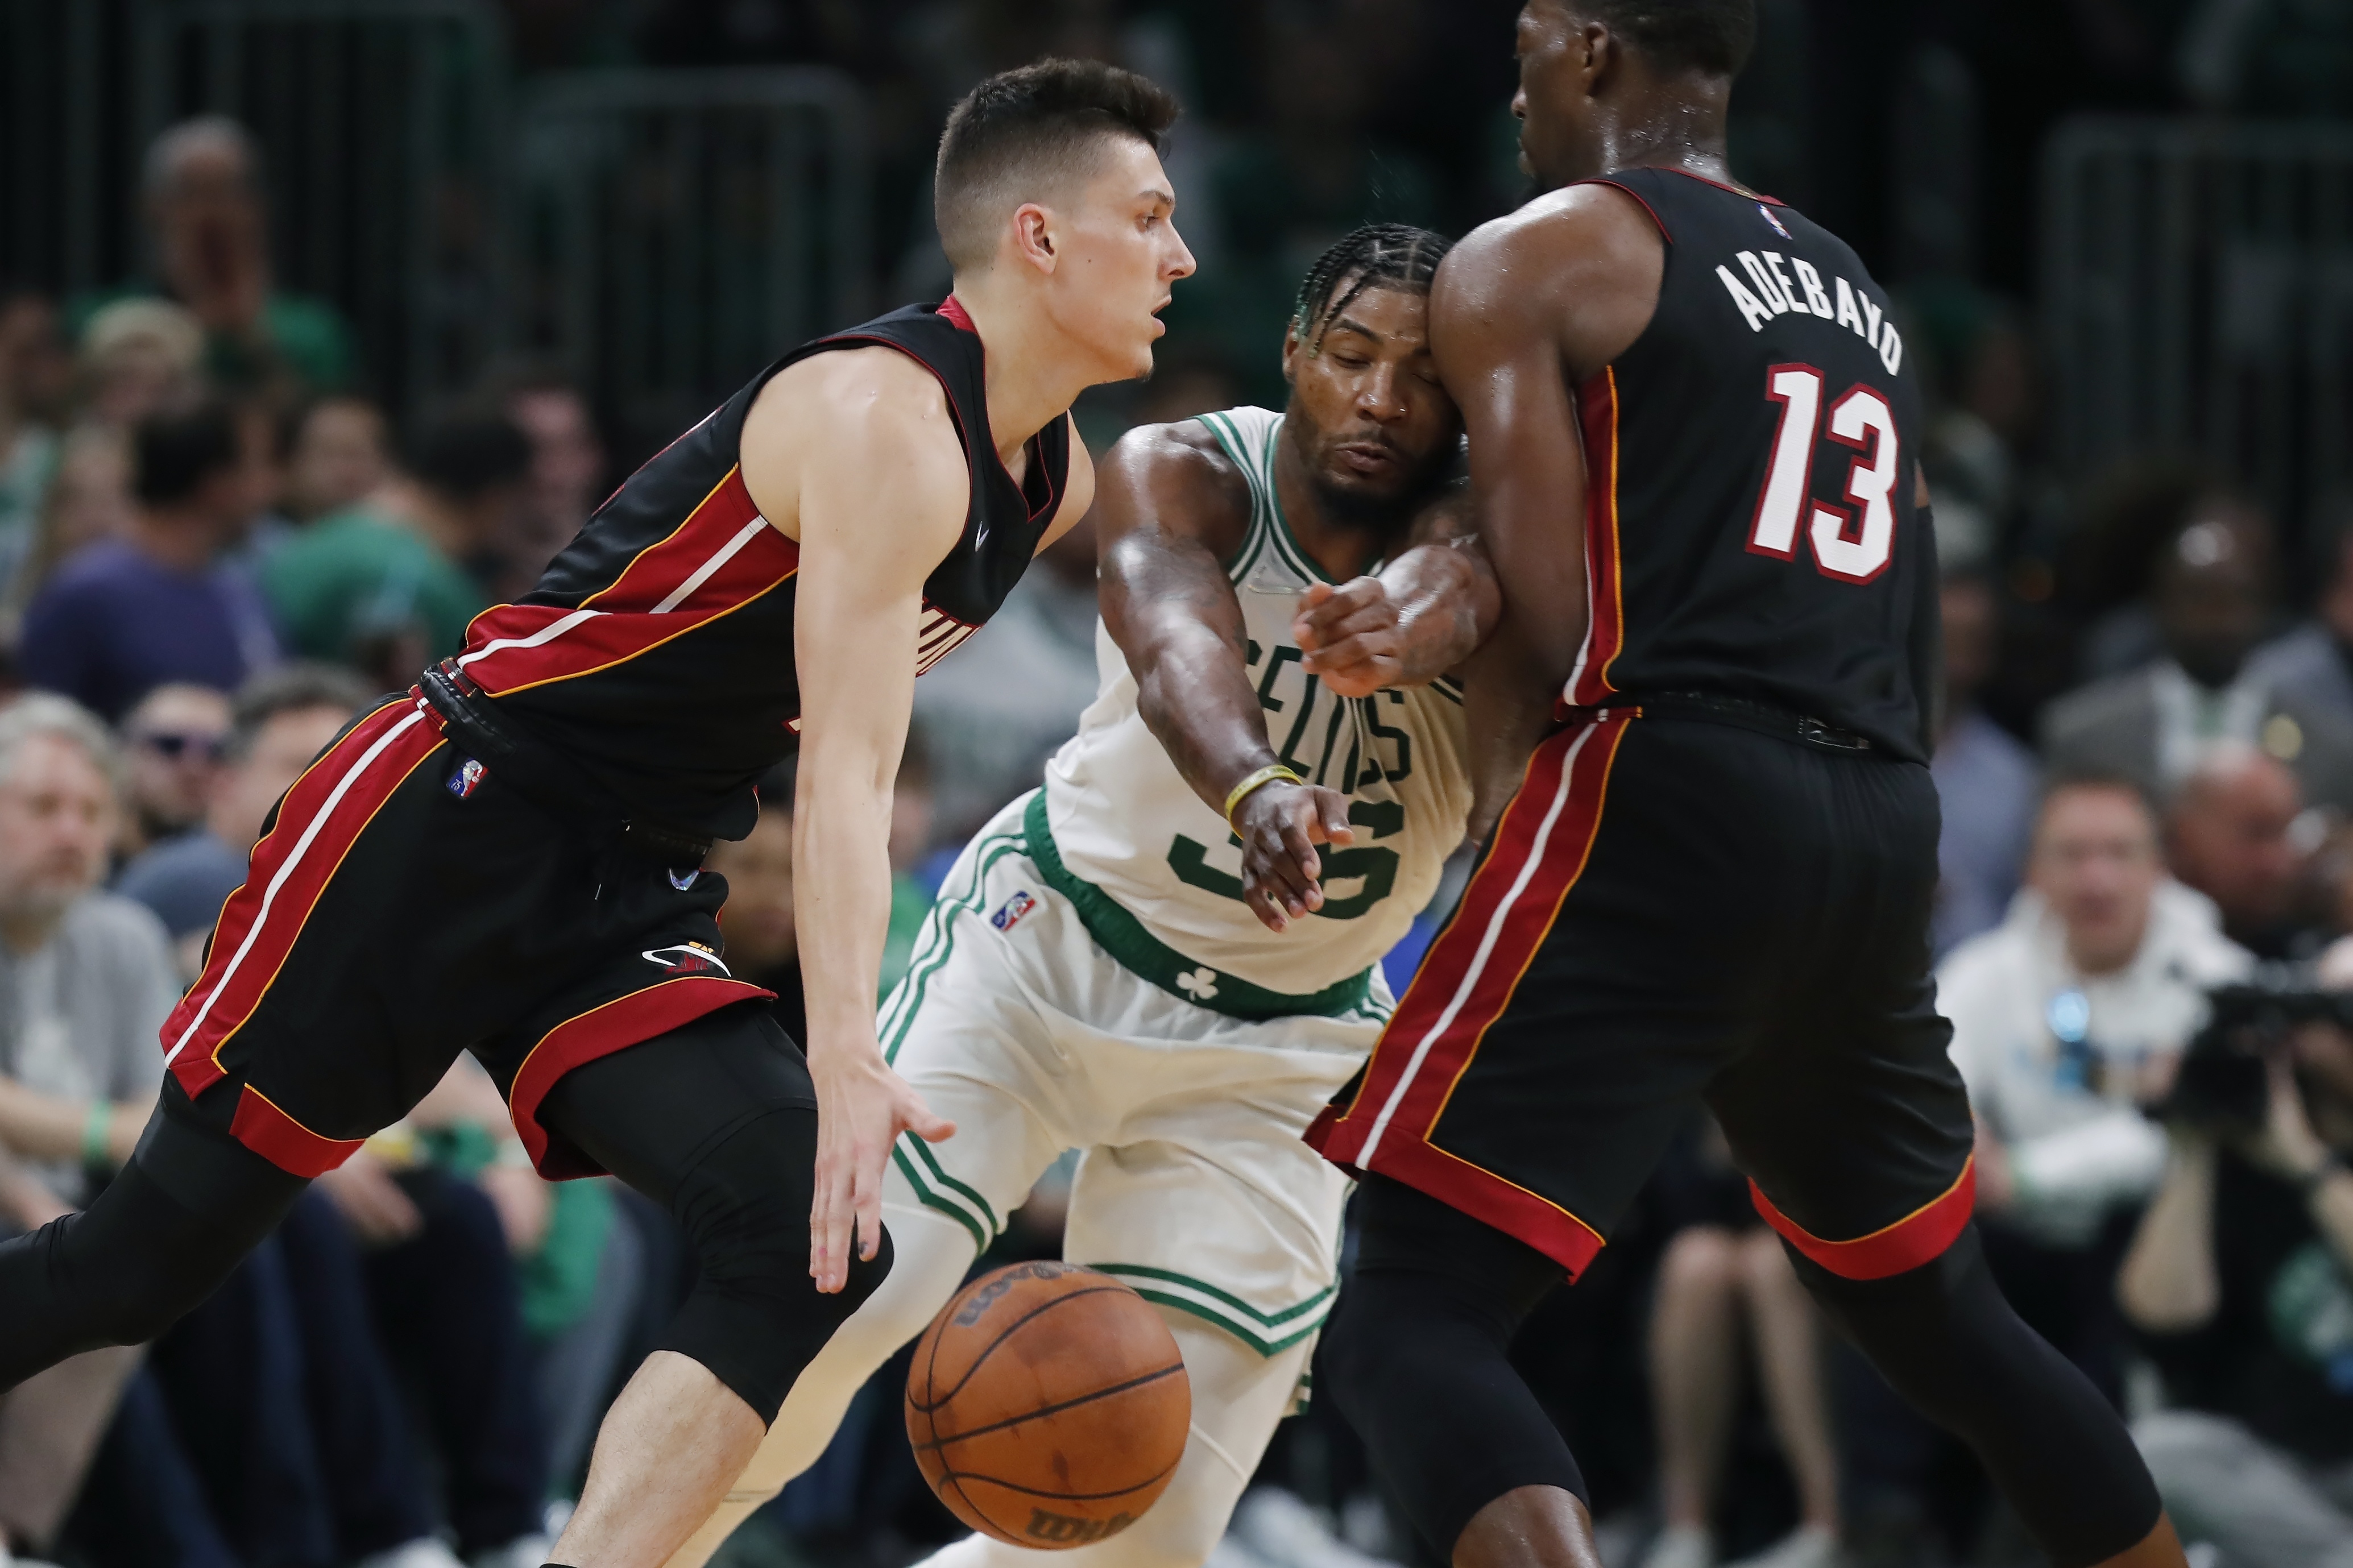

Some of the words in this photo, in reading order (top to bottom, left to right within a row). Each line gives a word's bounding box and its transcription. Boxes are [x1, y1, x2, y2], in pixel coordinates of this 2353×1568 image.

[1715, 250, 1903, 376] ADEBAYO
[1746, 363, 1899, 586] 13
[450, 778, 463, 791] 75
